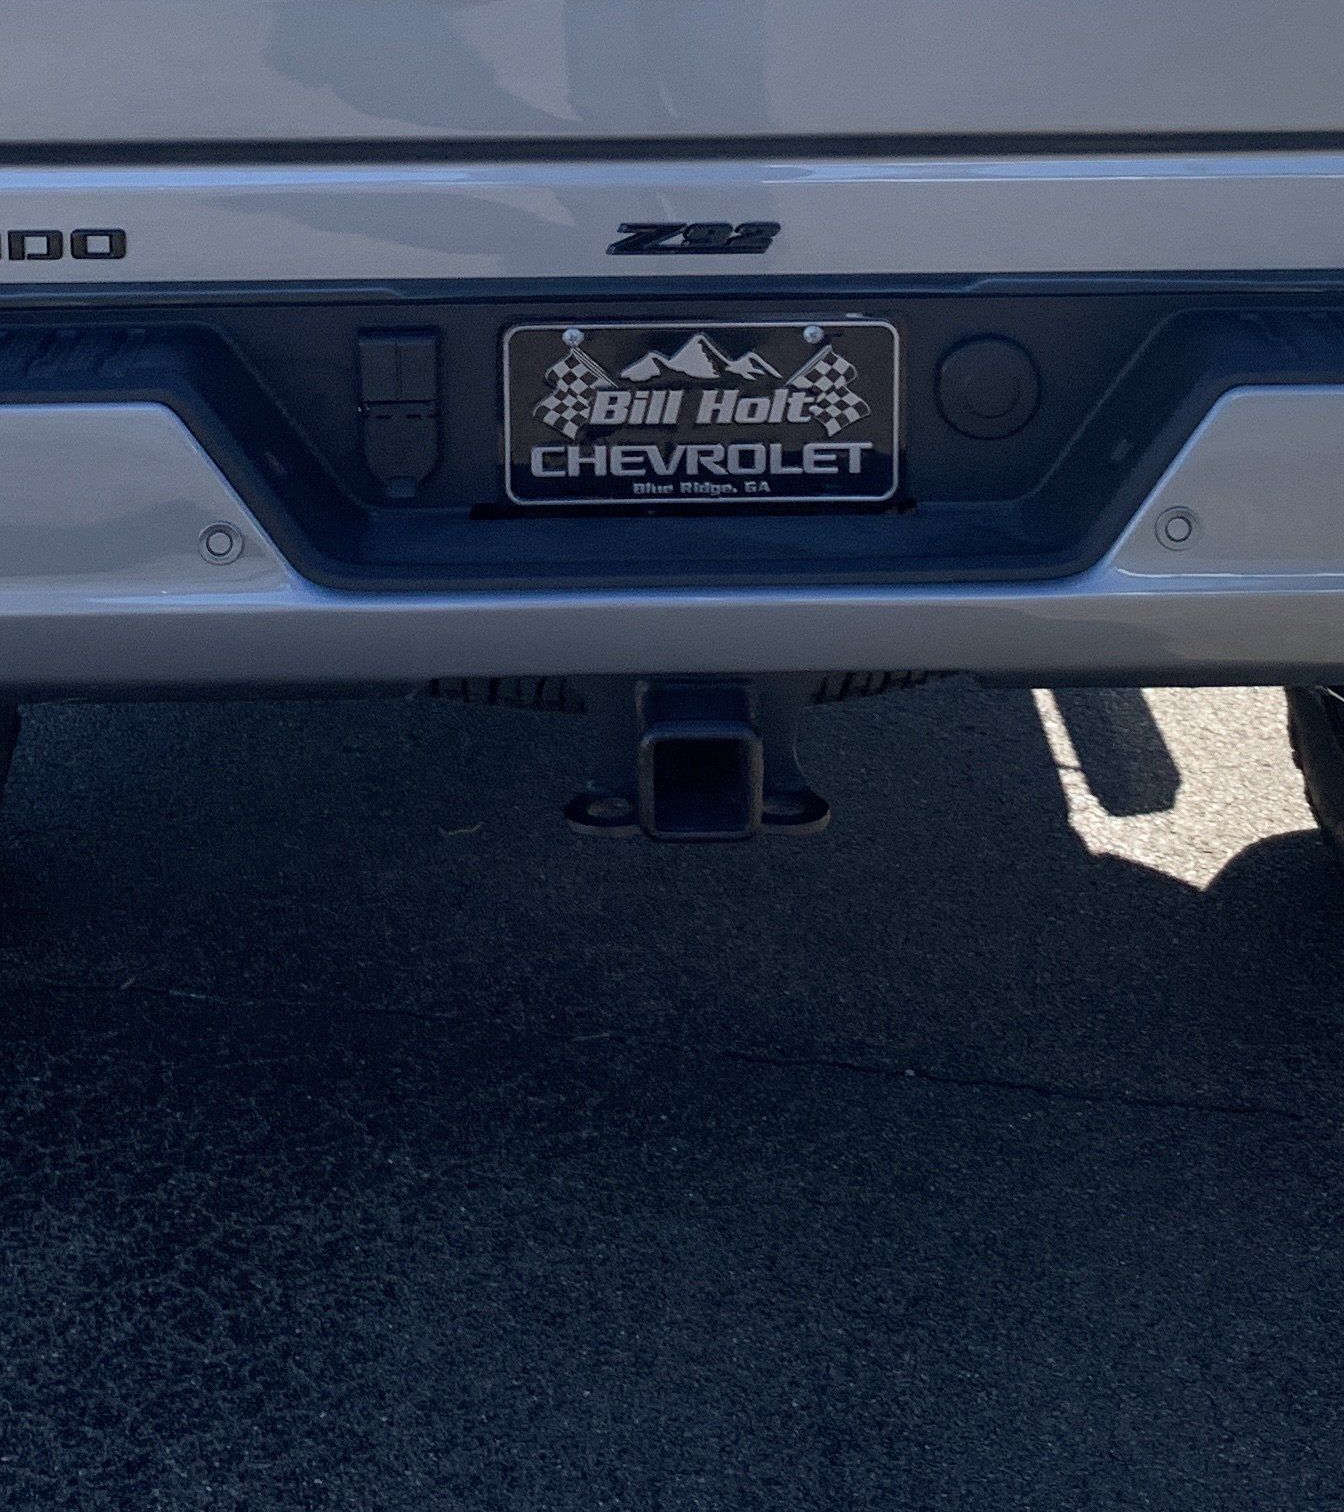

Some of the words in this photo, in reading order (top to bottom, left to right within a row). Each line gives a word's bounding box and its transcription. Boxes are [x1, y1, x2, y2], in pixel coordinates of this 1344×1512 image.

[589, 389, 683, 426] Bill
[696, 388, 817, 424] Holt
[531, 442, 873, 477] CHEVROLET
[633, 482, 674, 494] Blue
[744, 480, 771, 493] GA
